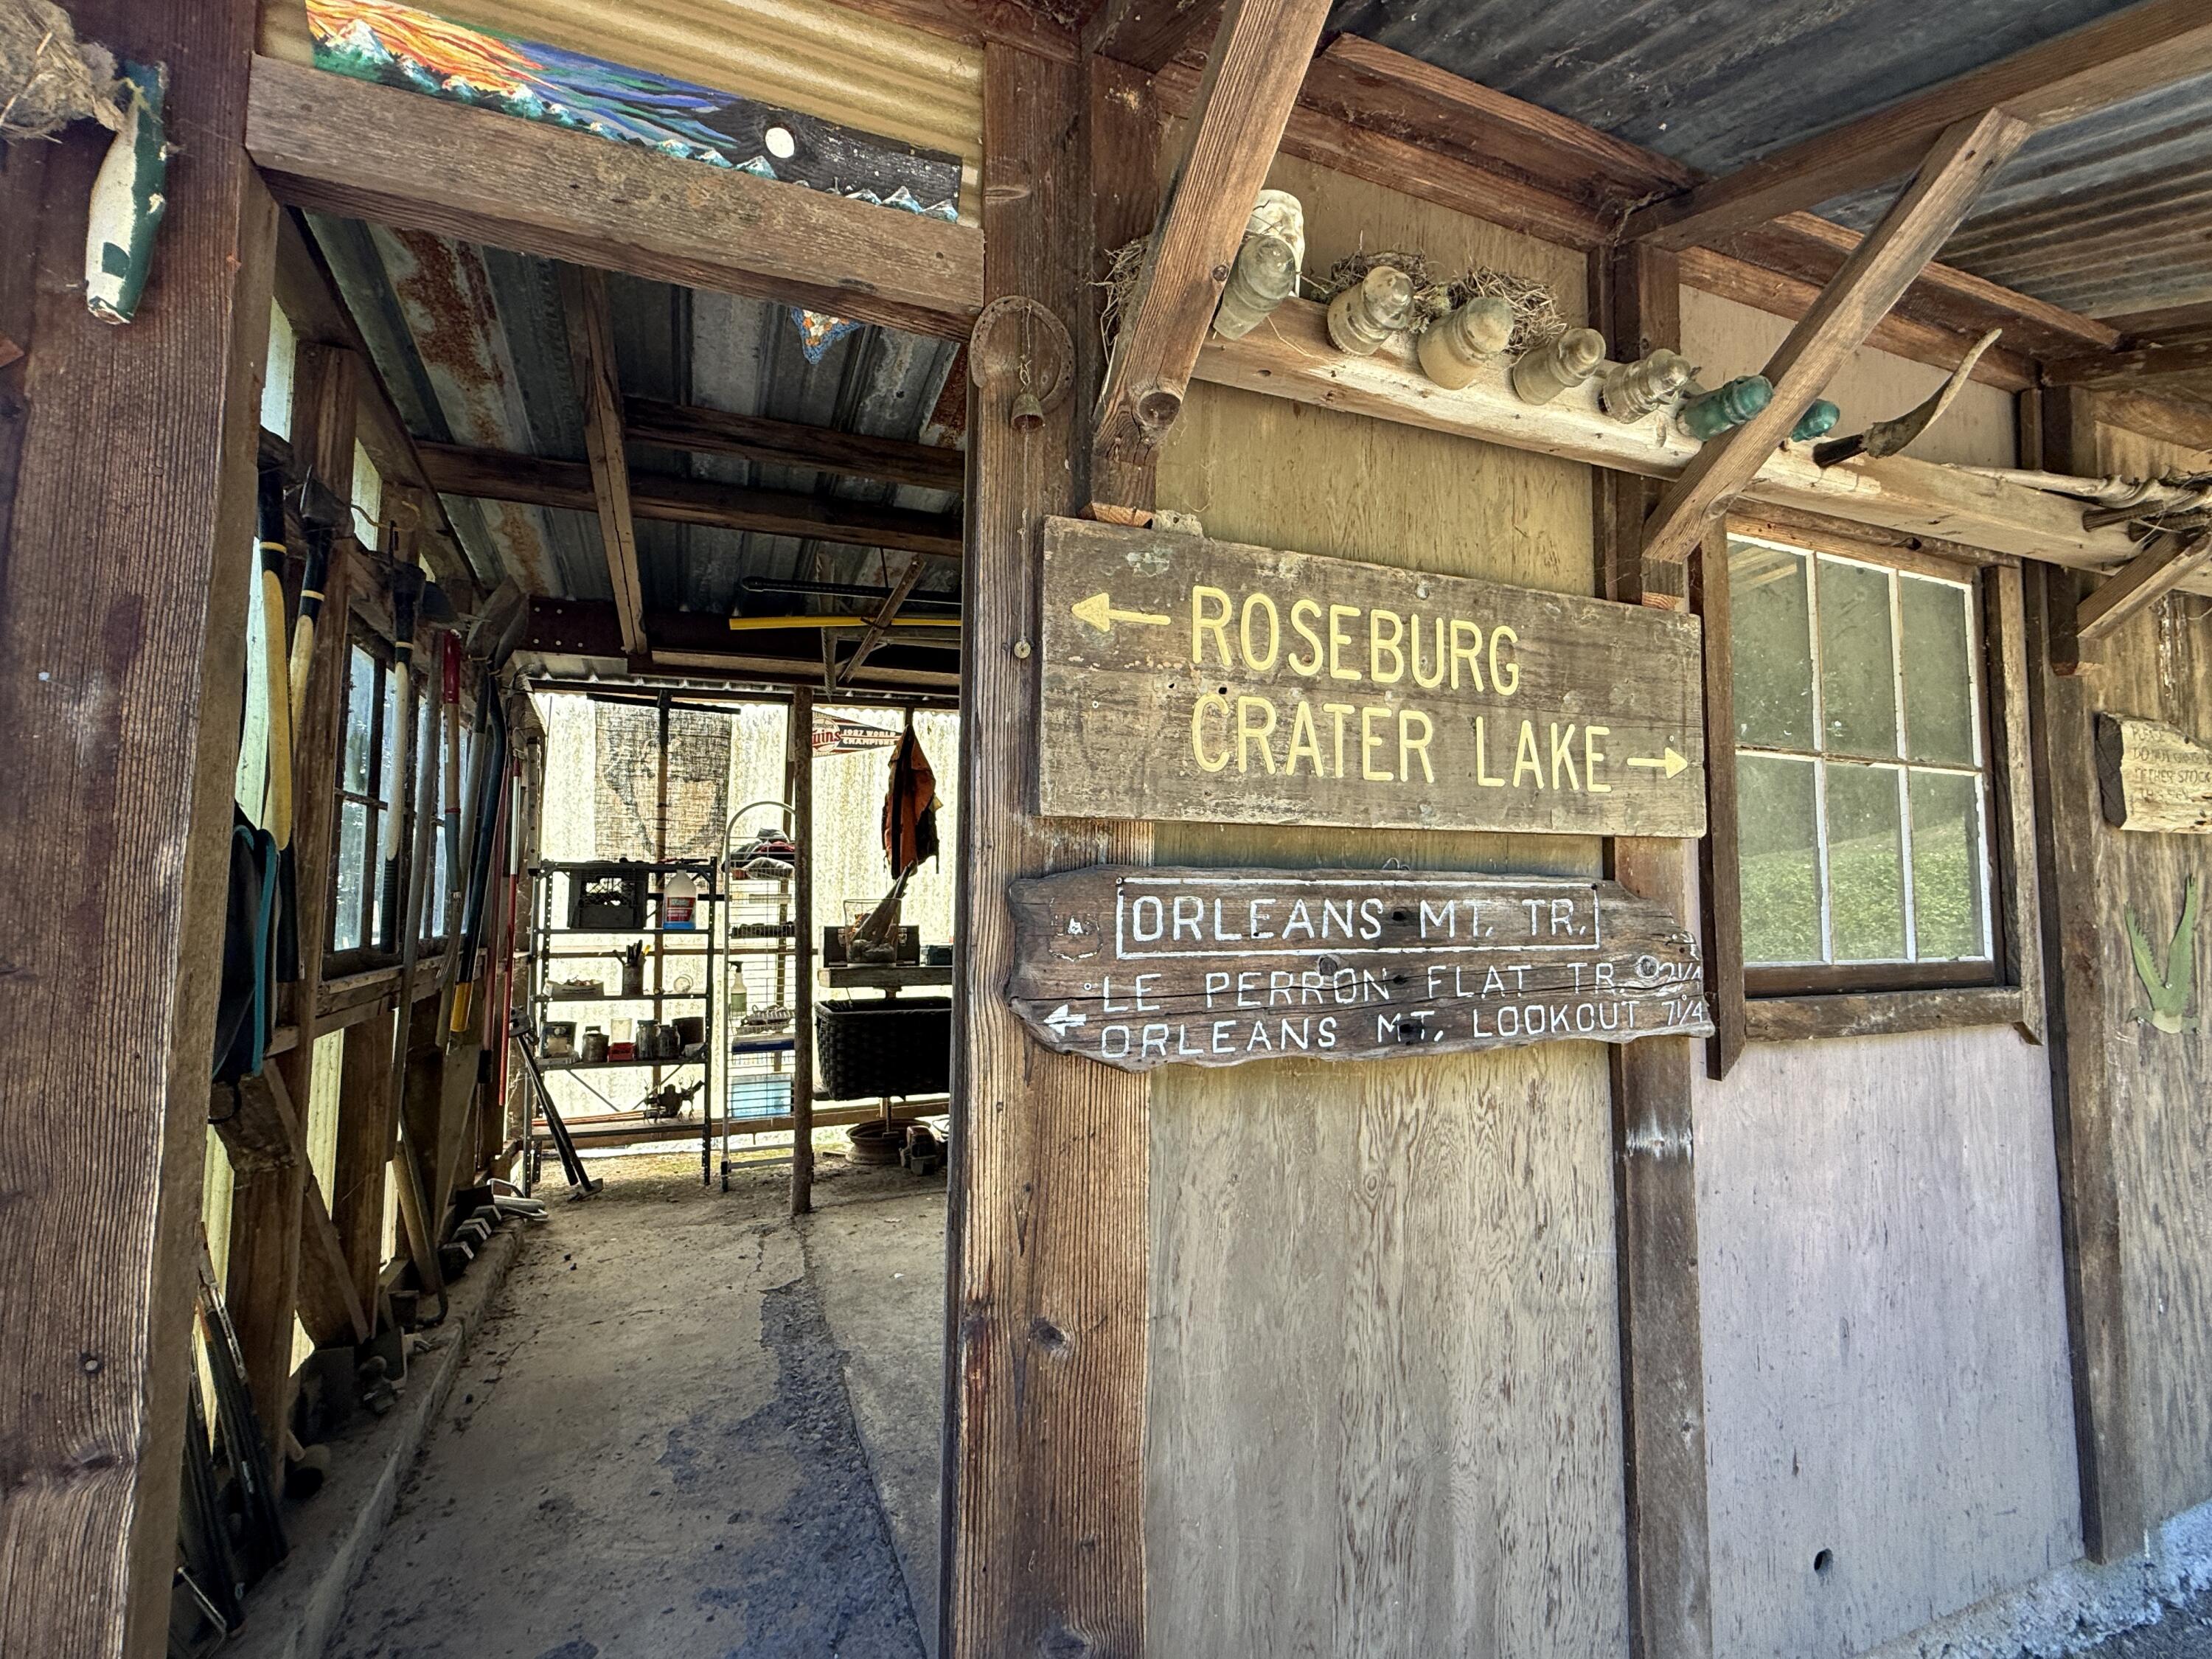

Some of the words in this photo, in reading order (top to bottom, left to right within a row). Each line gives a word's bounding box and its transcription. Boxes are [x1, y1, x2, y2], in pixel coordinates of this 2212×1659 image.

[1192, 585, 1520, 697] ROSEBURG
[1190, 694, 1435, 783] CRATER
[1475, 715, 1613, 793] LAKE
[2134, 745, 2149, 762] DO
[2177, 770, 2211, 785] STOCK
[1133, 895, 1383, 942] ORLEANS
[1102, 973, 1163, 1012] LE
[1206, 967, 1391, 1009] PERRON
[1427, 964, 1532, 1000] FLAT
[1101, 1016, 1338, 1059] ORLEANS
[1473, 1000, 1641, 1039] LOOKOUT
